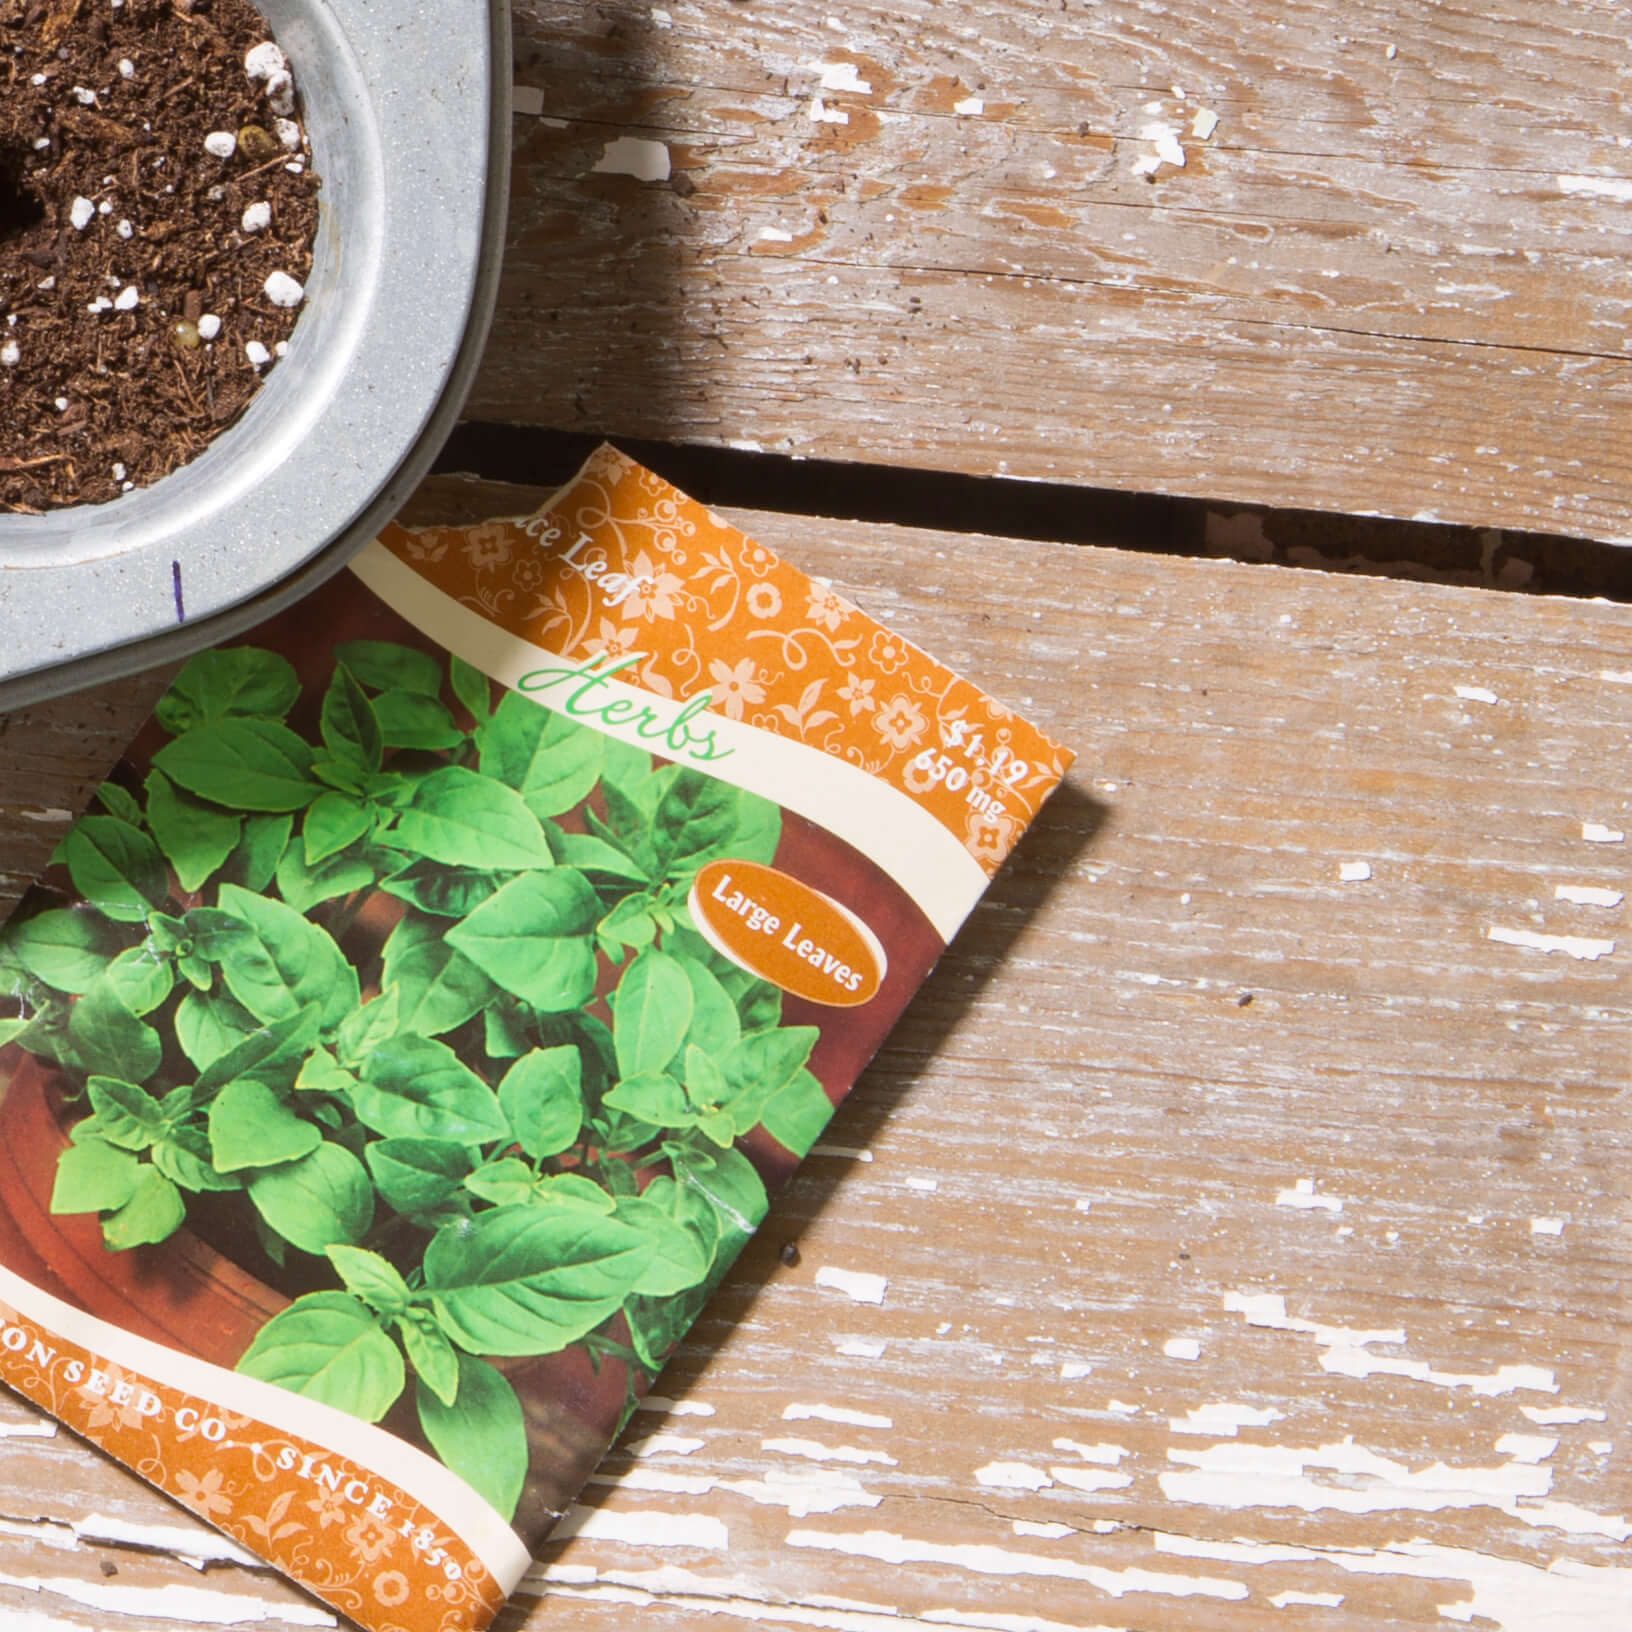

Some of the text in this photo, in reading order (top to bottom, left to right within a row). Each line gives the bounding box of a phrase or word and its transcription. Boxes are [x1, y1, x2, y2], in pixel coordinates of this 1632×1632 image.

[558, 531, 654, 607] Leaf
[518, 652, 735, 761] Herbs
[912, 747, 1006, 824] 650 mg
[944, 720, 1028, 787] $1.19
[712, 875, 864, 993] Large Leaves
[63, 1358, 163, 1417] SEED
[174, 1408, 235, 1448] CO.
[276, 1446, 390, 1519] SINCE
[398, 1514, 464, 1582] 1850
